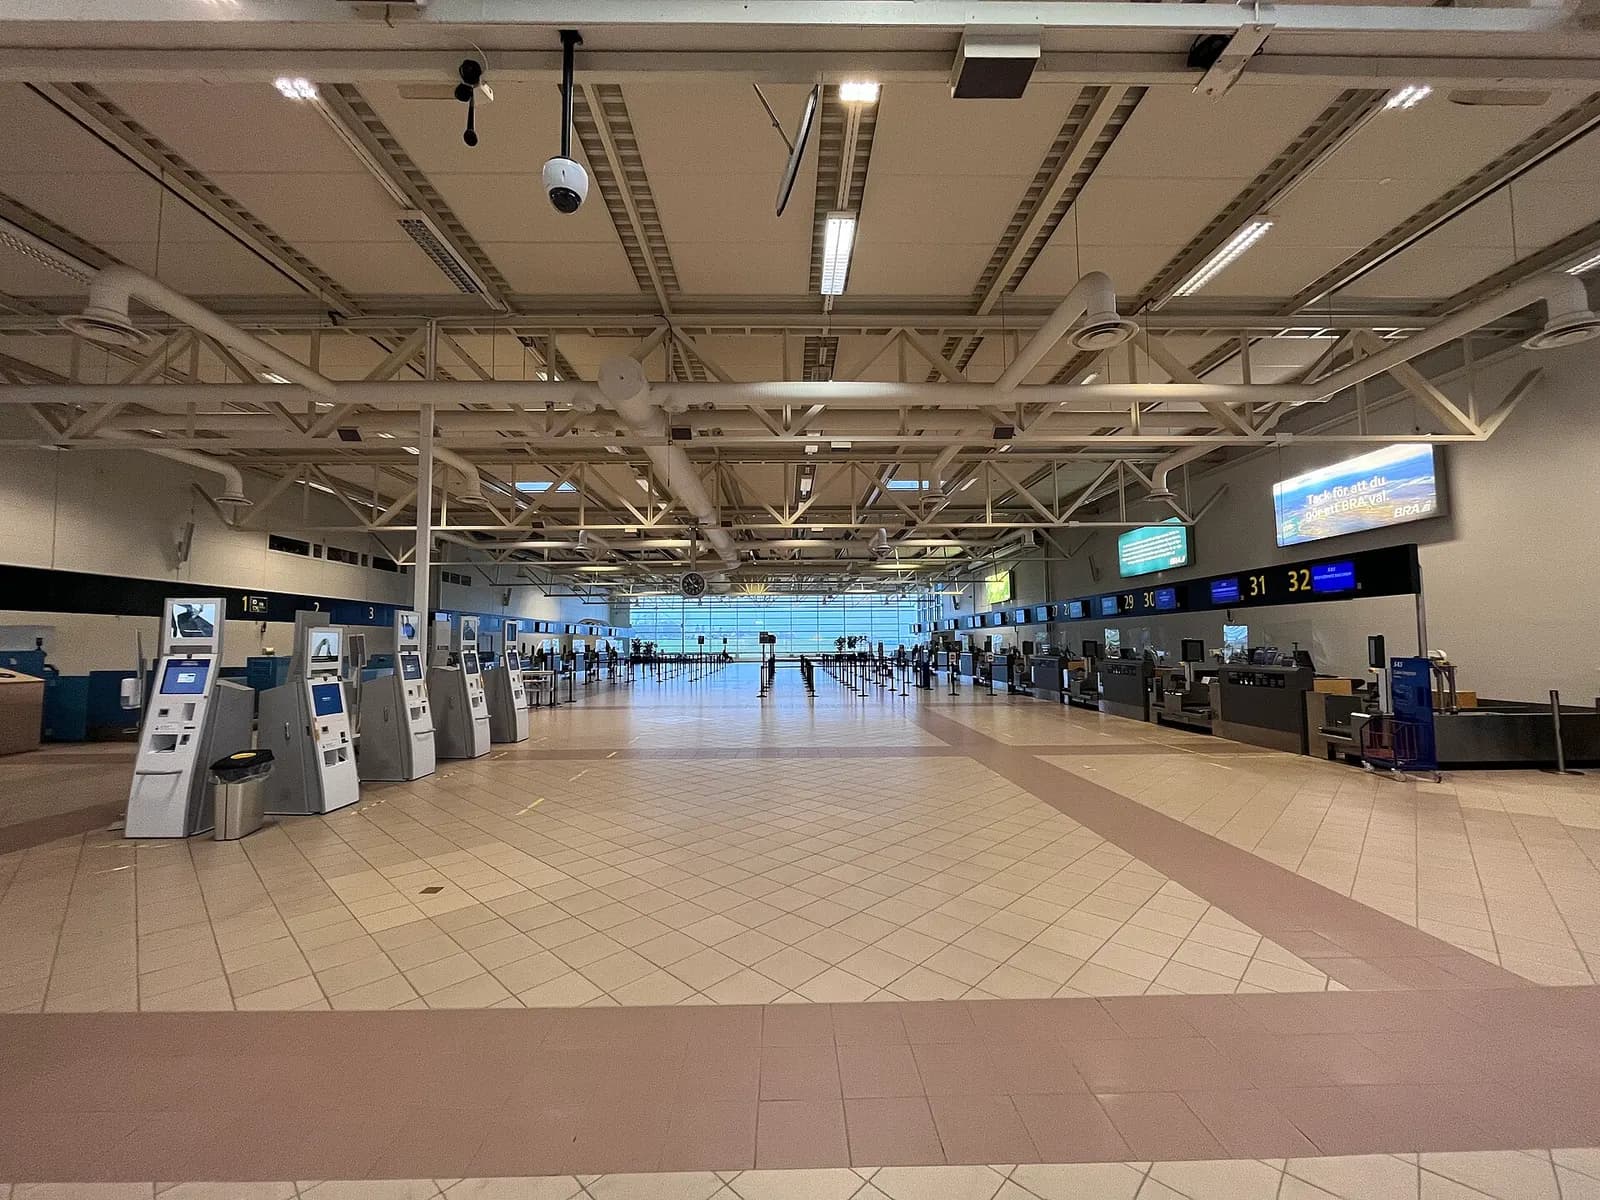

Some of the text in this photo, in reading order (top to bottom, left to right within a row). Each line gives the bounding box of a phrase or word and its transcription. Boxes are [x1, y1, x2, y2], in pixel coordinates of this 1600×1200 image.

[1308, 476, 1386, 504] Tack för att du
[1393, 503, 1420, 518] BRA
[1250, 575, 1266, 596] 31
[1288, 569, 1311, 592] 32
[242, 595, 248, 612] 1
[1124, 594, 1134, 609] 29
[368, 607, 375, 620] 3
